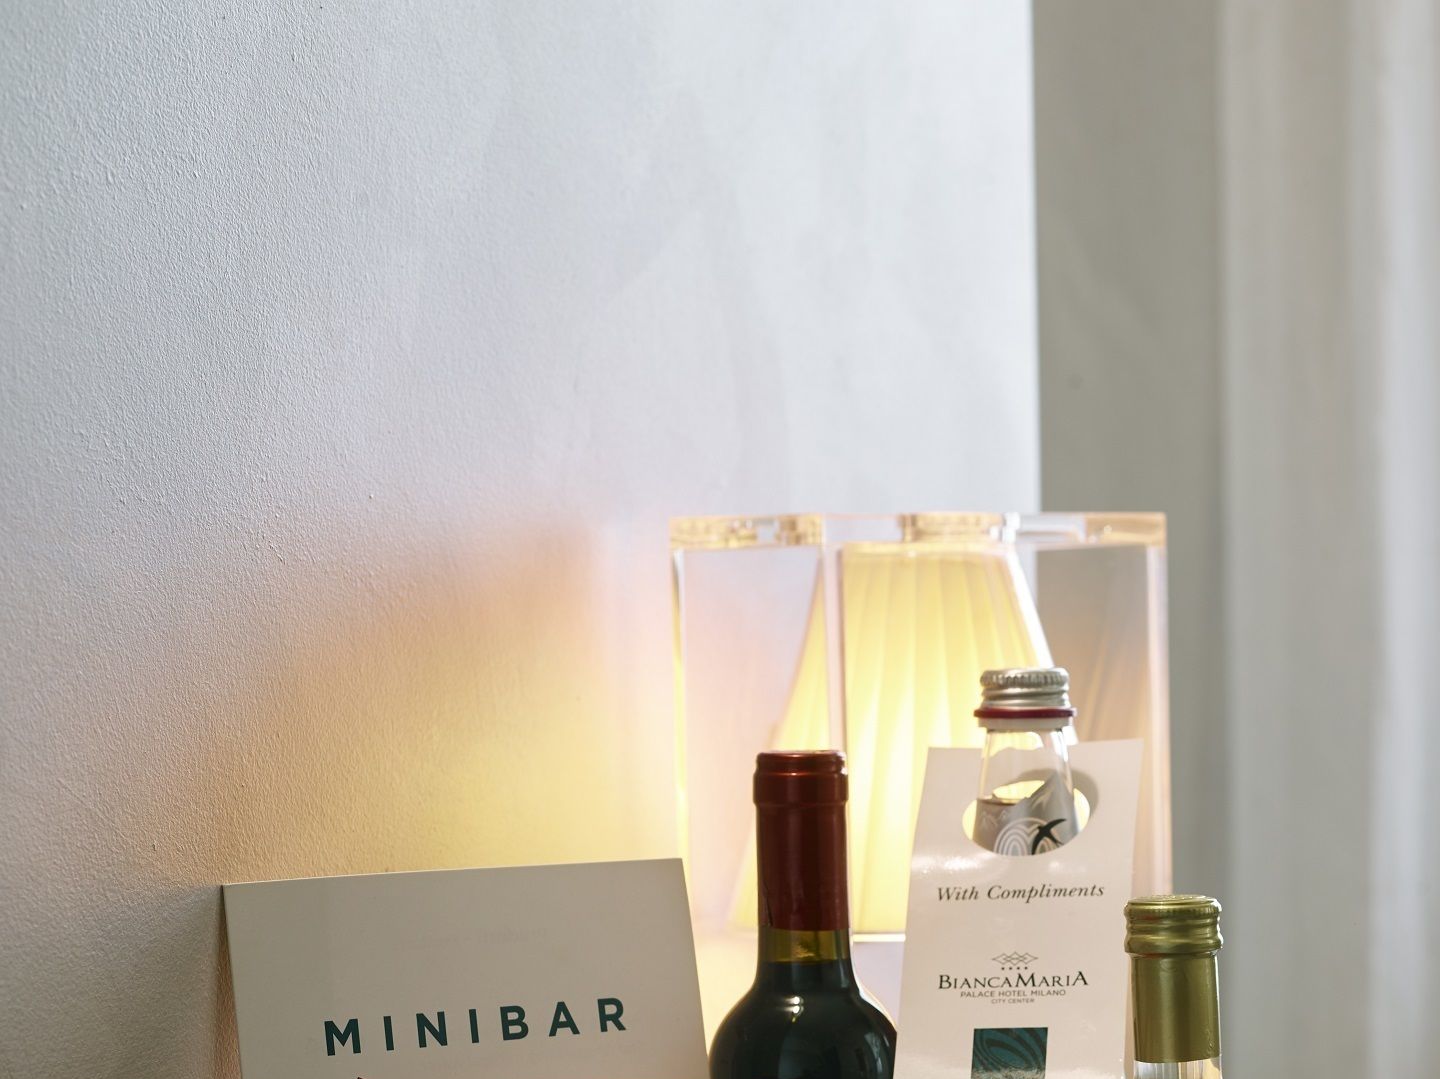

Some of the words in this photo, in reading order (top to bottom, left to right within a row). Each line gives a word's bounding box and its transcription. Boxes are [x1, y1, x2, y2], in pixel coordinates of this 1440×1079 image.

[937, 886, 979, 901] With
[987, 883, 1105, 904] Compliments
[960, 990, 995, 998] PALACE
[998, 989, 1027, 997] HOTEL
[1031, 989, 1066, 997] MILANO
[324, 997, 627, 1057] MINIBAR
